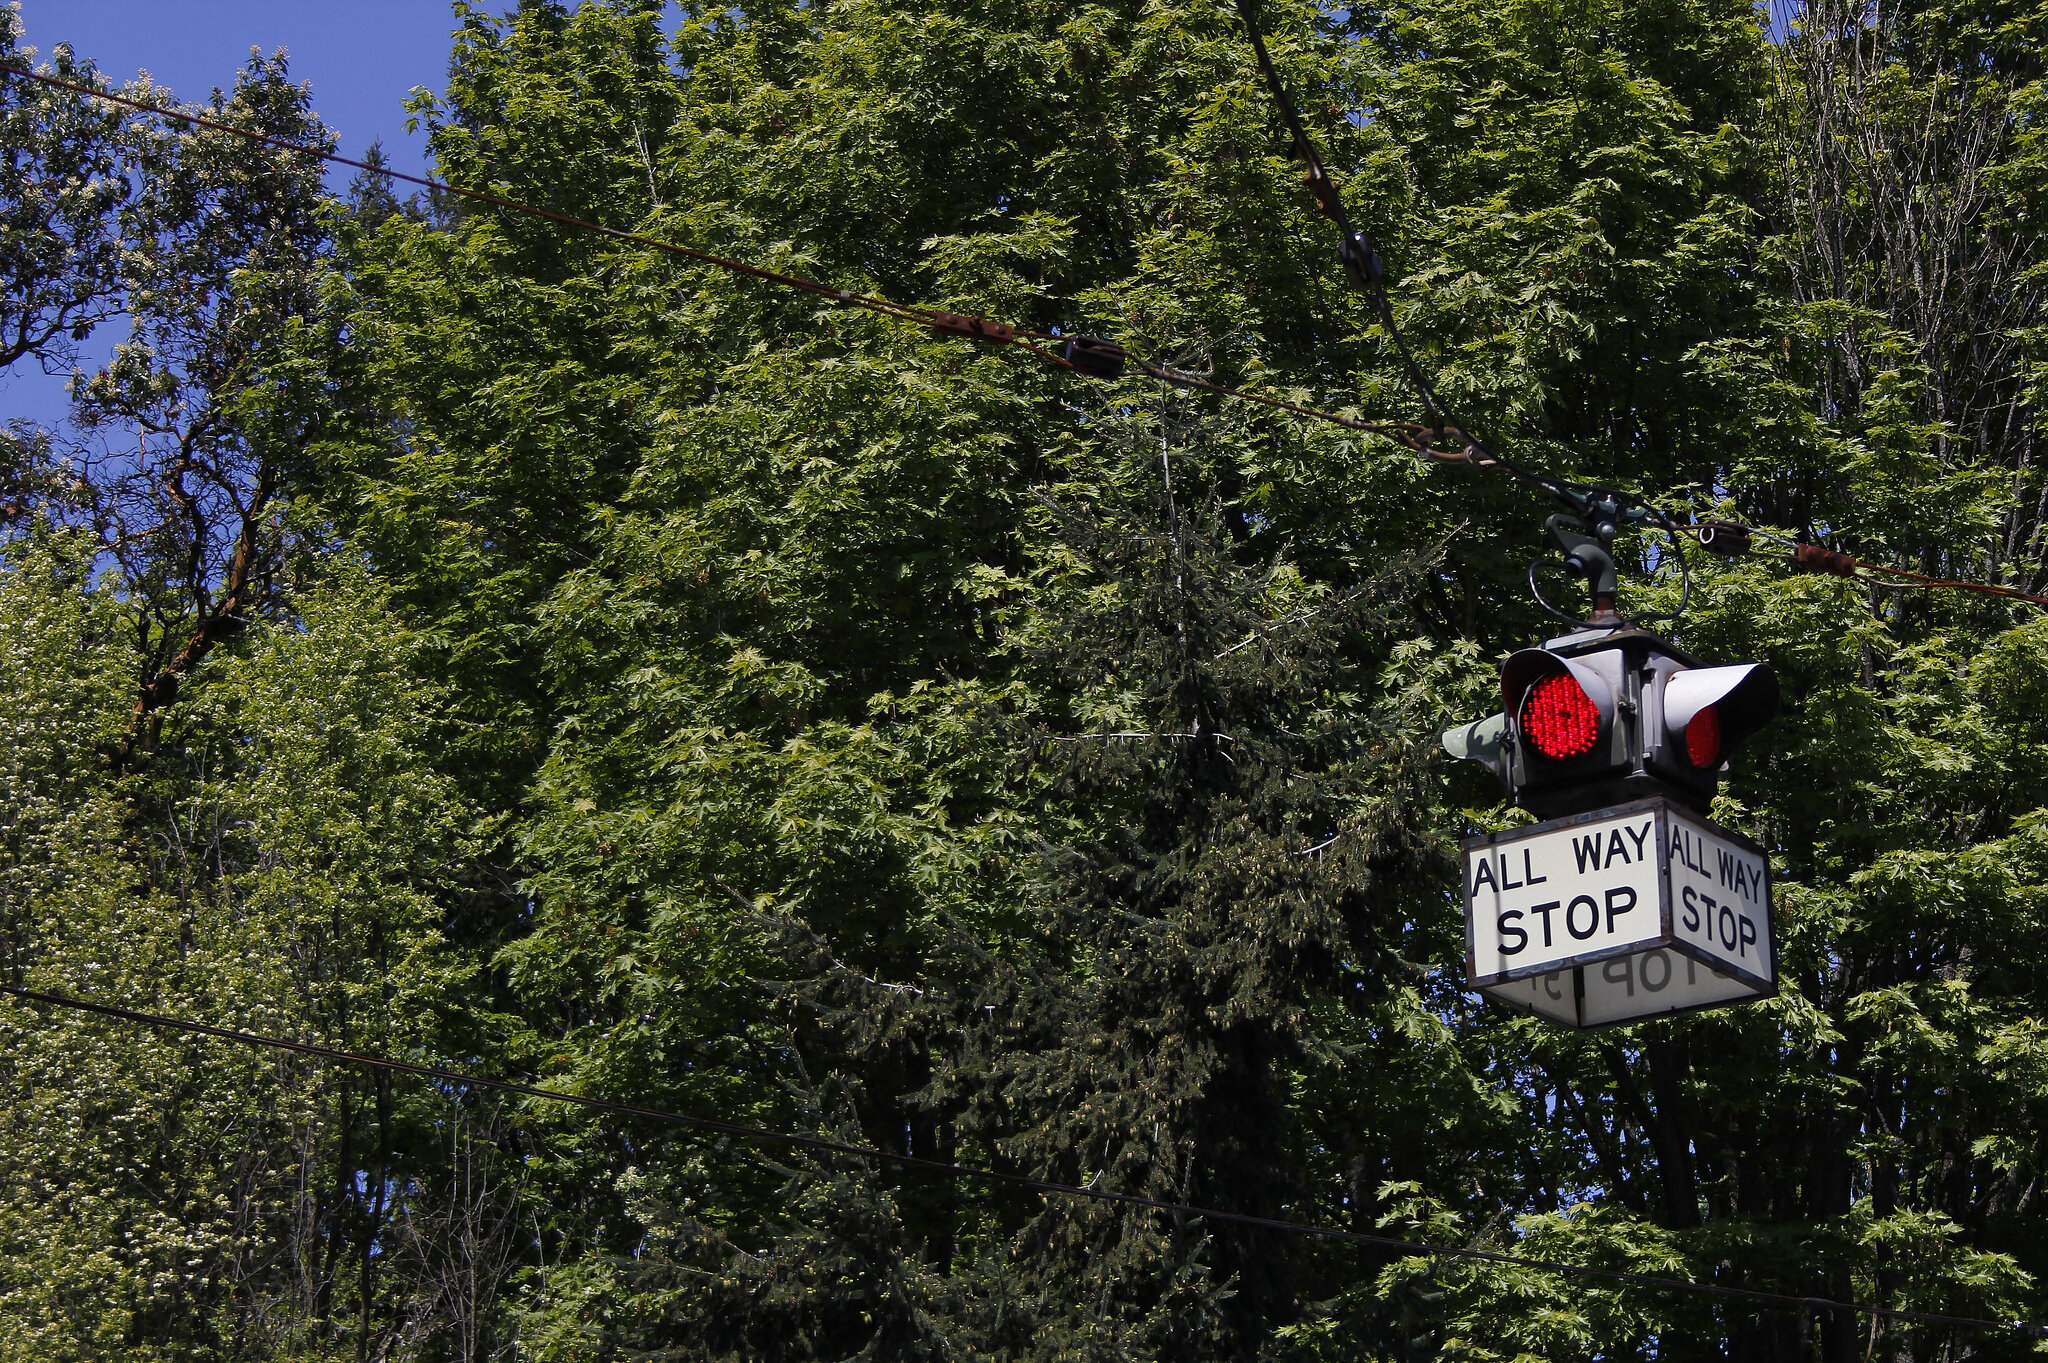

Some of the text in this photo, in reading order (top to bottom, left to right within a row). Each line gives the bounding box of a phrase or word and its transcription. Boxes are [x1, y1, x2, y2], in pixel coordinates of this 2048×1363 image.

[1472, 821, 1652, 897] ALL WAY
[1669, 824, 1762, 904] ALL WAY
[1496, 886, 1638, 956] STOP
[1682, 885, 1757, 958] STOP
